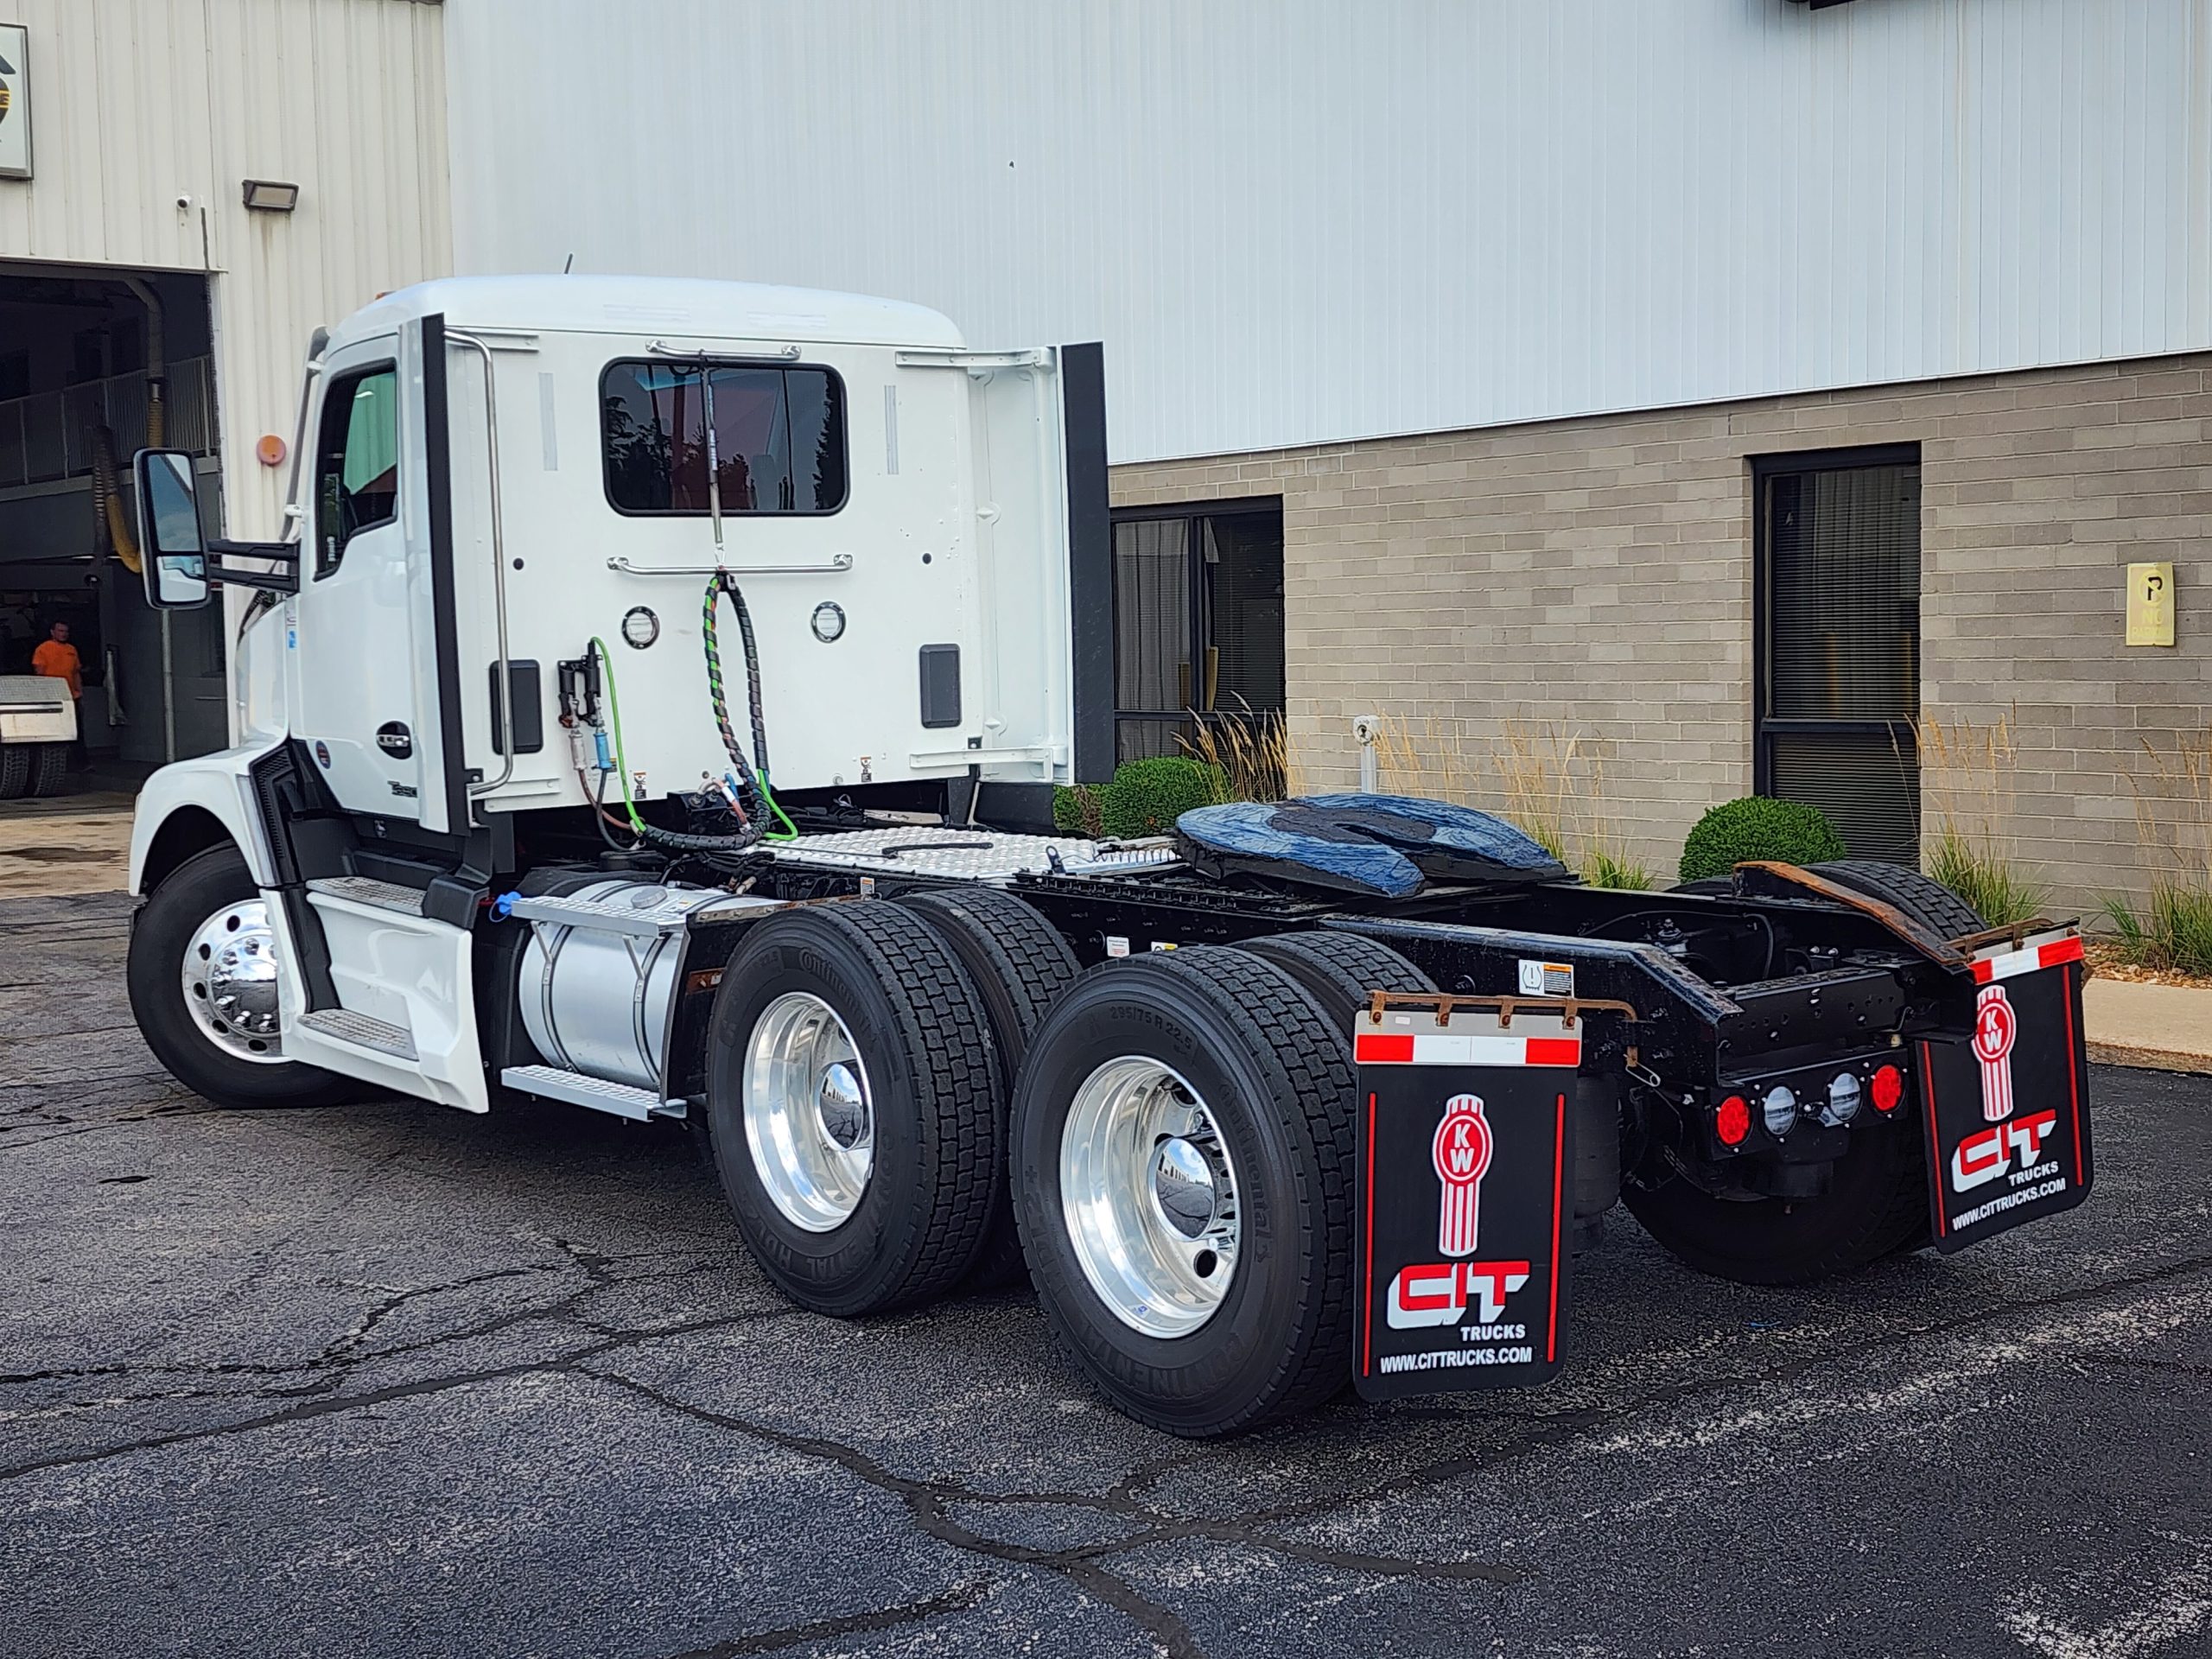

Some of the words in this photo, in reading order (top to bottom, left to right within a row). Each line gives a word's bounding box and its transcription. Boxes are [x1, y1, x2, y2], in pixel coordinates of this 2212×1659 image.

[1154, 1014, 1163, 1030] R
[1165, 1021, 1192, 1050] 22.5
[2008, 1160, 2059, 1188] TRUCKS
[1952, 1178, 2066, 1231] WWW.CITTRUCKS.COM
[1460, 1323, 1526, 1343] TRUCKS
[1379, 1346, 1533, 1375] WWW.CITTRUCKS.COM
